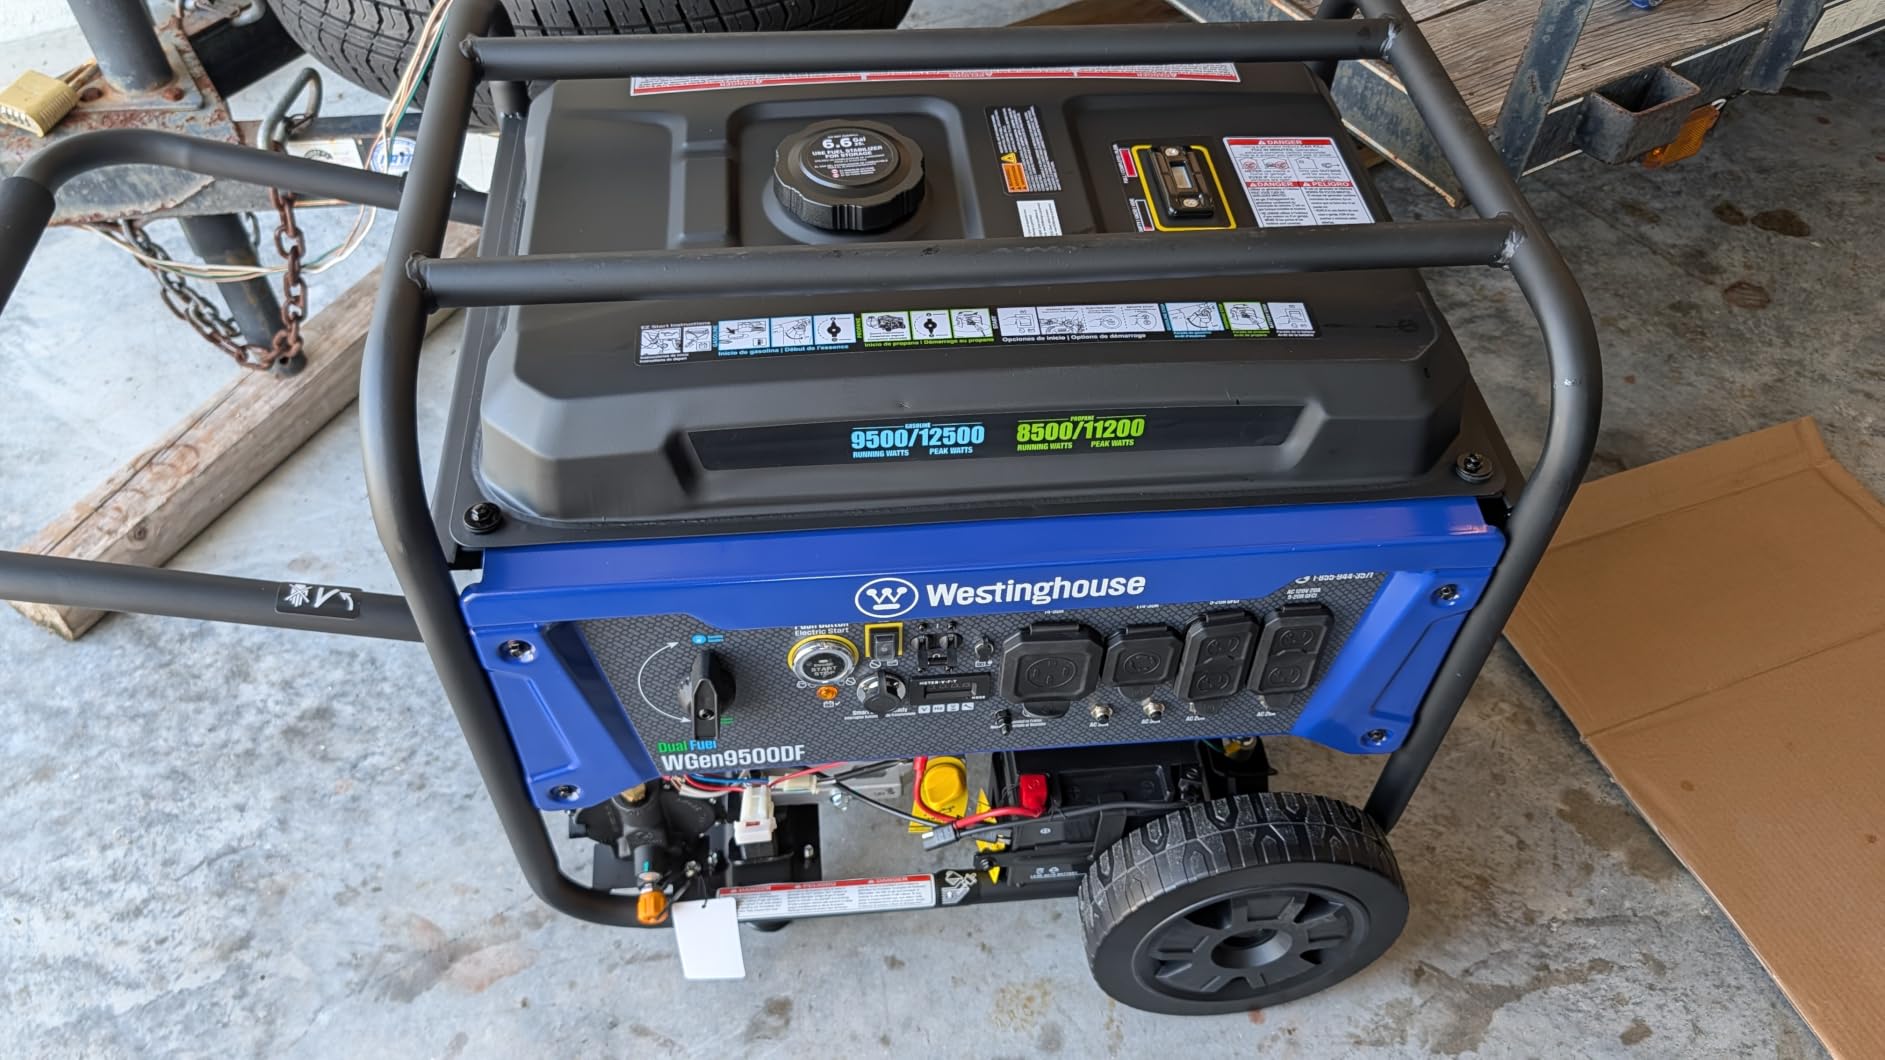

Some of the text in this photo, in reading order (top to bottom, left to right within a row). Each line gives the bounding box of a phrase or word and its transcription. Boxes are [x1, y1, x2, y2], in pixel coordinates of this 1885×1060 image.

[822, 137, 852, 149] 6.6
[845, 145, 883, 154] STABILIZER
[1071, 333, 1098, 341] Options
[749, 348, 779, 356] gasolina
[1016, 418, 1146, 443] 8500/11200
[851, 425, 985, 450] 9500/12500
[1017, 442, 1073, 452] RUNNING WATTS
[1090, 439, 1135, 448] PEAK WATTS
[852, 449, 910, 459] RUNNING WATTS
[929, 446, 973, 455] PEAK WATTS
[926, 576, 1146, 607] Westinghouse
[794, 629, 827, 637] Electric
[811, 665, 837, 673] START
[657, 738, 717, 753] Dual Fuel
[661, 744, 805, 772] WGen9500DF
